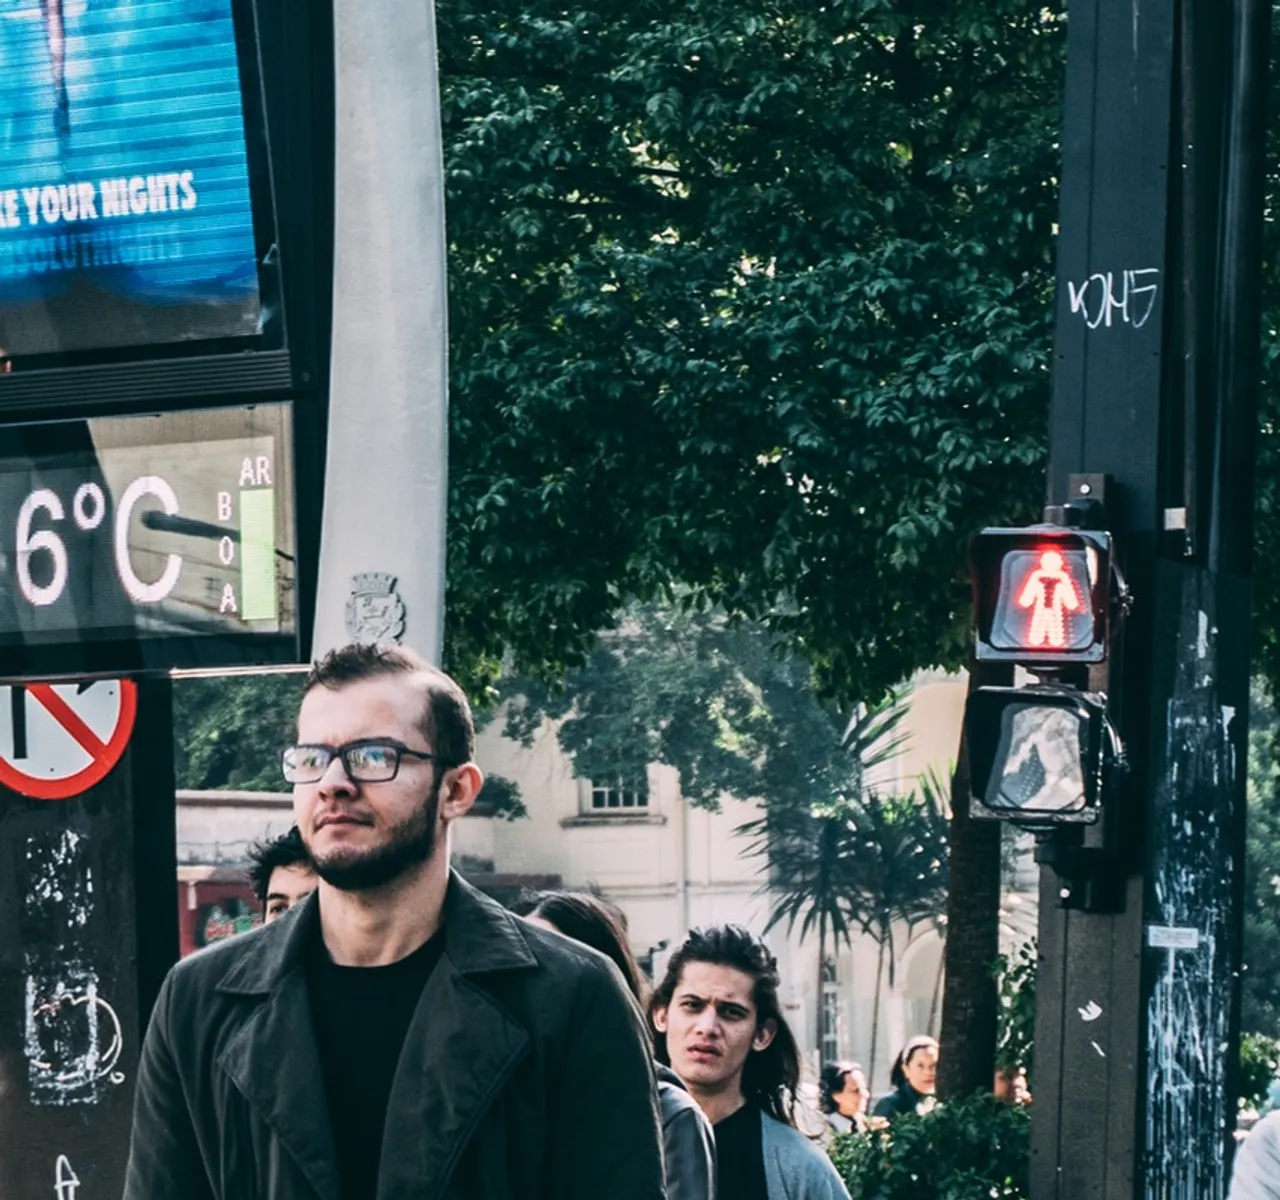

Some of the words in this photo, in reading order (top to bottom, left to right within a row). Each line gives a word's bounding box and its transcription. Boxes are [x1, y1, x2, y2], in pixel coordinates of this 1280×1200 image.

[22, 182, 98, 225] YOUR
[101, 170, 197, 217] NIGHTS
[239, 456, 271, 486] AR
